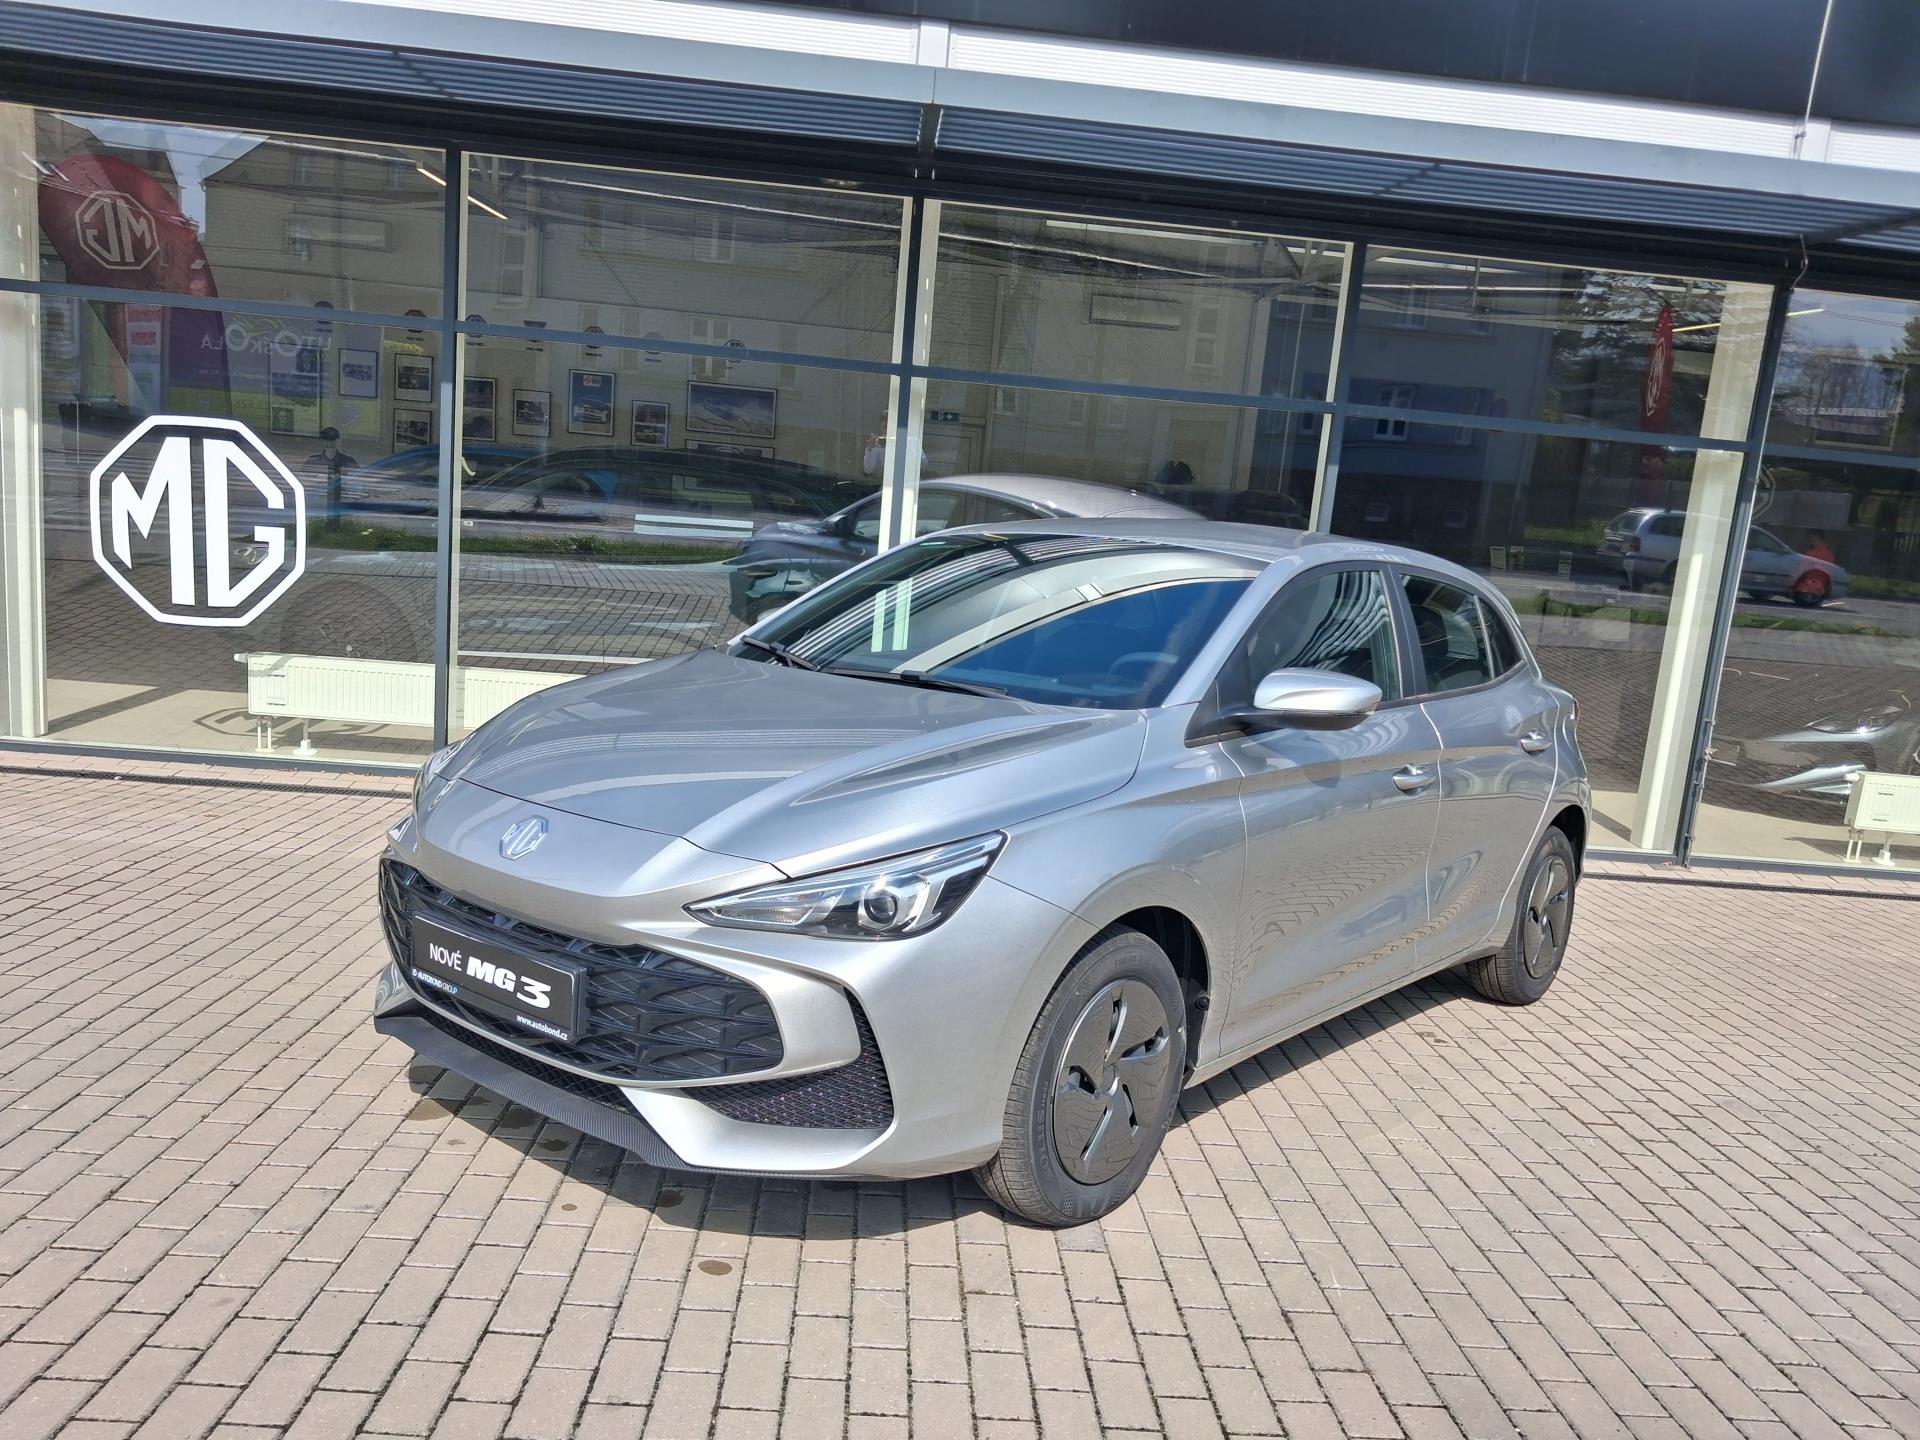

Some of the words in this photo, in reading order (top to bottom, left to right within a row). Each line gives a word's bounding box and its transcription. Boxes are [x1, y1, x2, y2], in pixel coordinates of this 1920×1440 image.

[111, 436, 285, 608] MG
[501, 816, 548, 859] MG
[429, 942, 462, 972] NOVÉ
[416, 971, 443, 988] AUTOBOND
[442, 982, 458, 995] GROUP
[516, 1014, 568, 1040] www.autobond.cz
